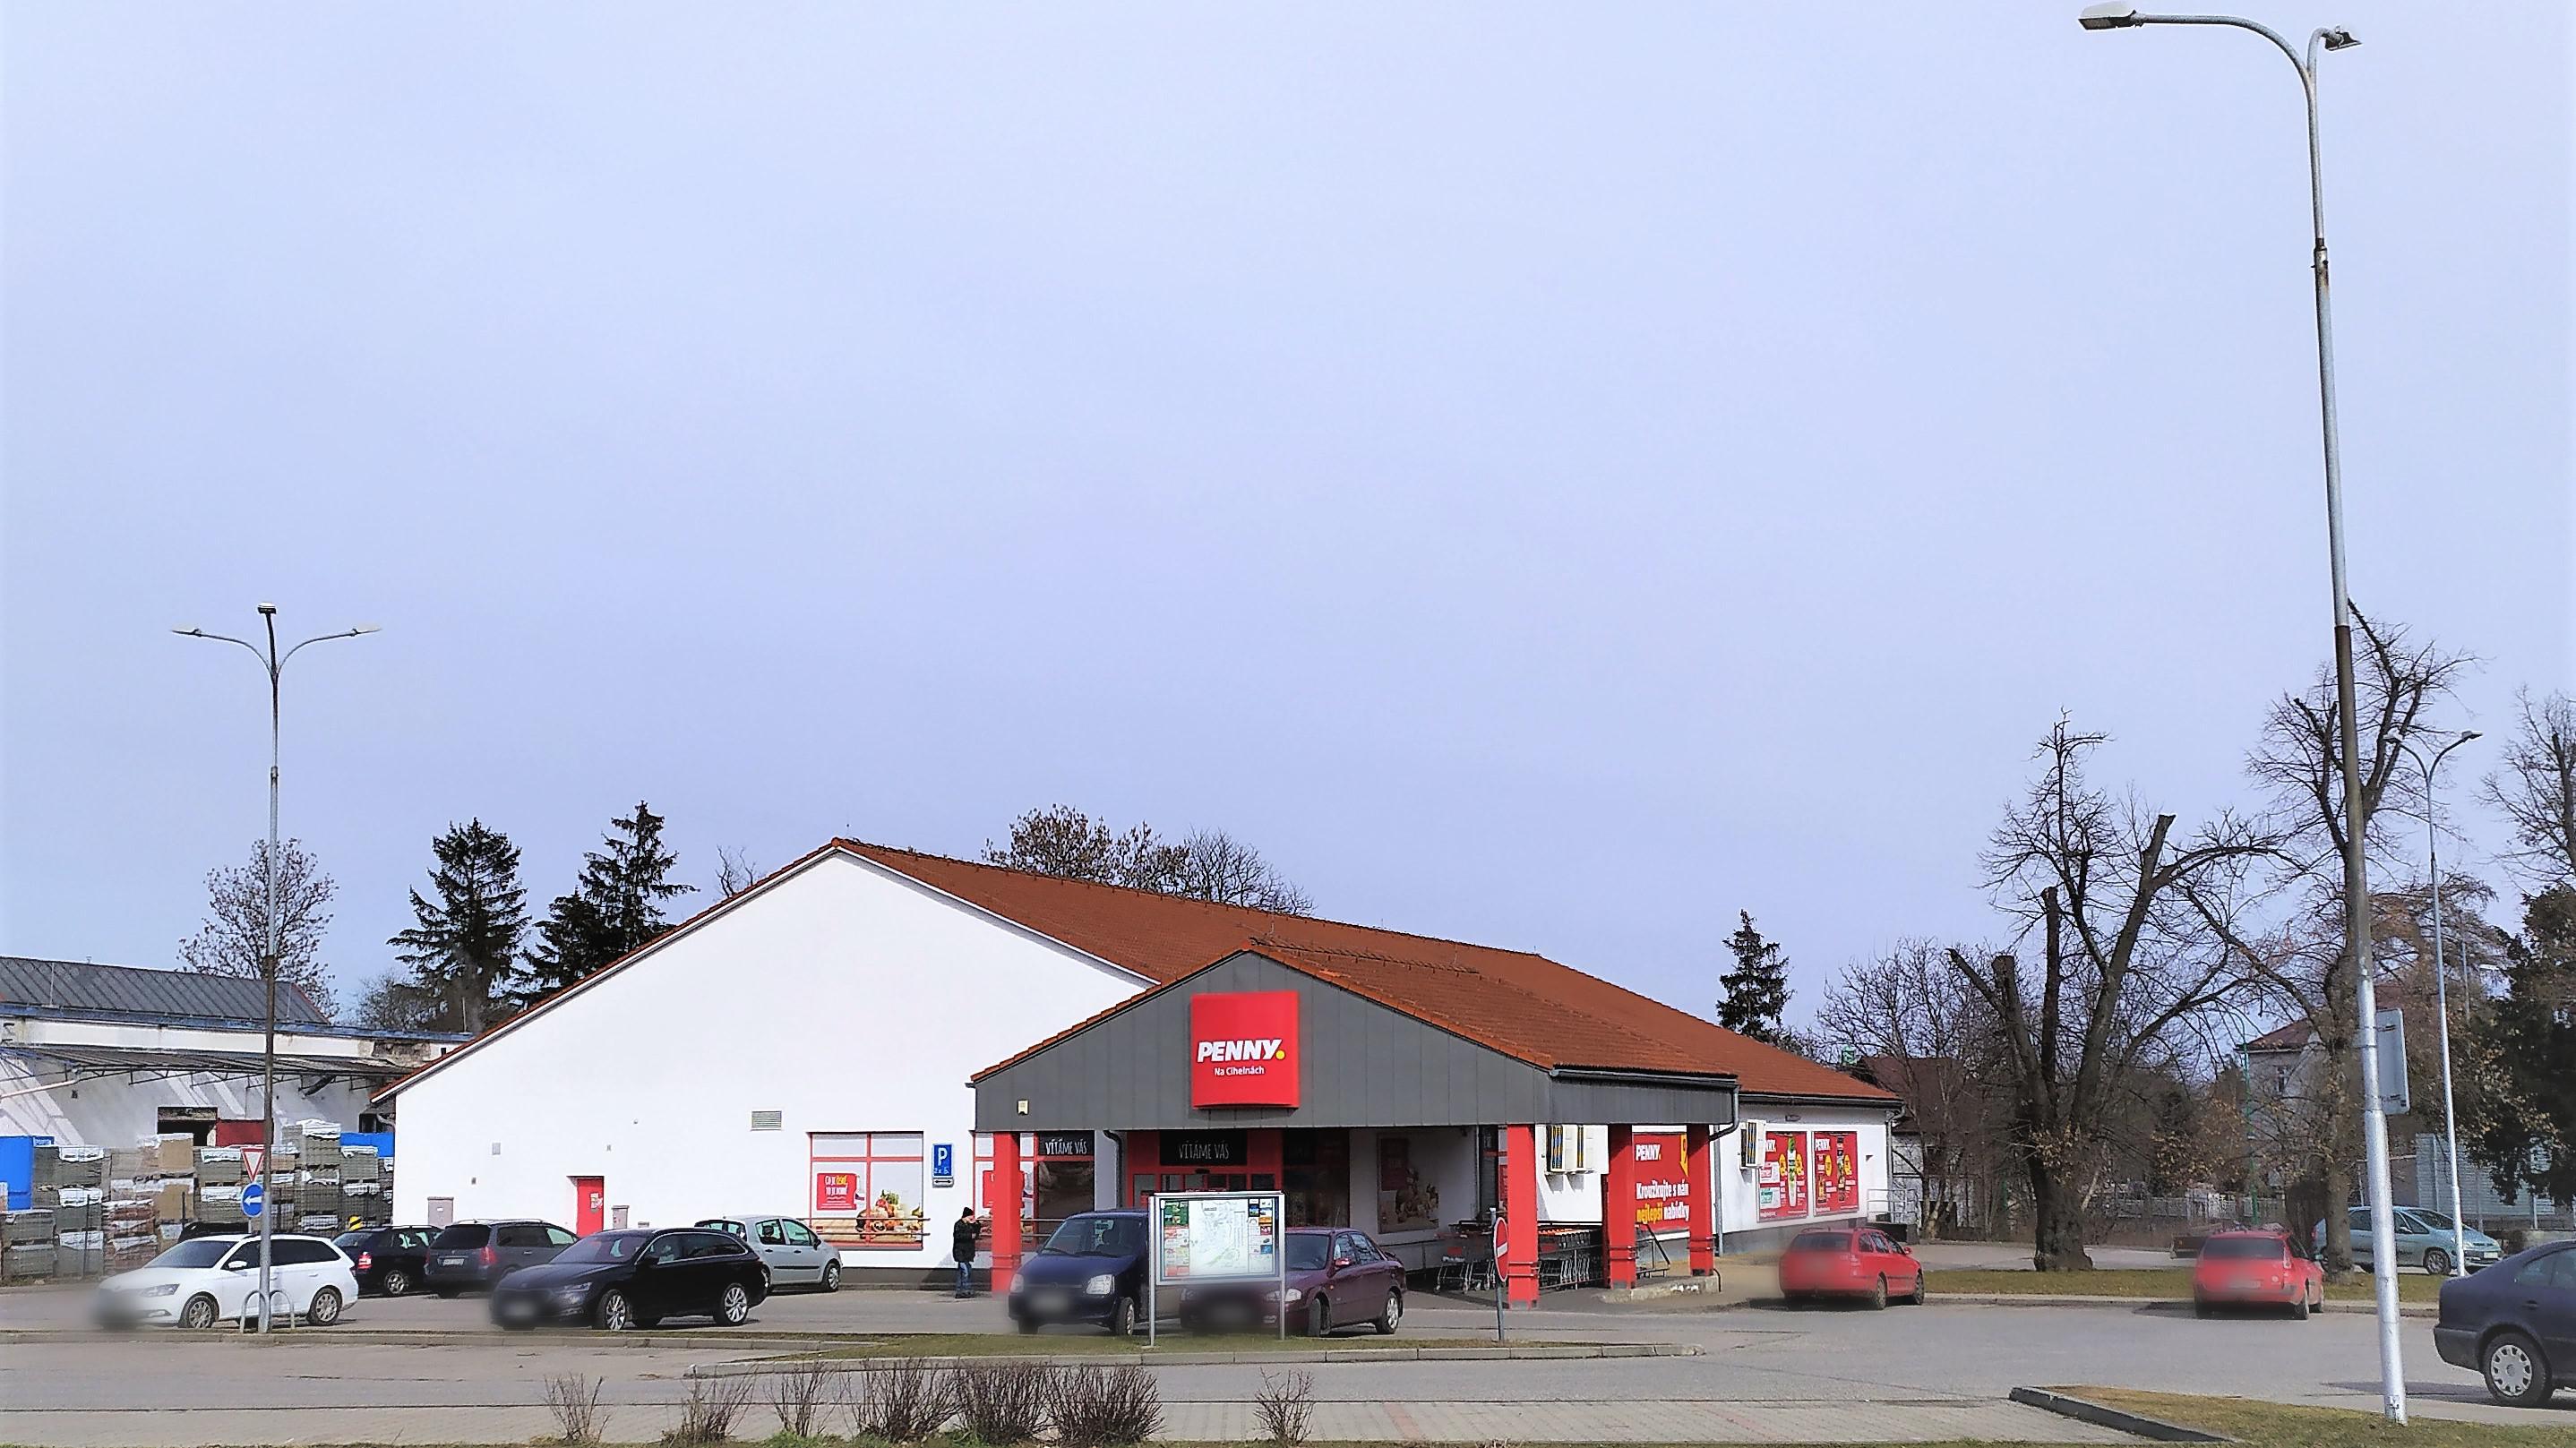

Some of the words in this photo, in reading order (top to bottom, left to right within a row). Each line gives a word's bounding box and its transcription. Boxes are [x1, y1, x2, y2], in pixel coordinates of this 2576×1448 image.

[1214, 1067, 1224, 1075] Na
[1225, 1066, 1265, 1075] Cihelnách
[1045, 1138, 1073, 1155] VÍTÁME
[1074, 1138, 1087, 1154] VÁS
[1178, 1140, 1212, 1160] VÍTÁME
[1214, 1140, 1229, 1160] VÁS
[938, 1147, 948, 1166] P
[1636, 1202, 1663, 1224] nejlepší
[1663, 1201, 1690, 1221] nabídky
